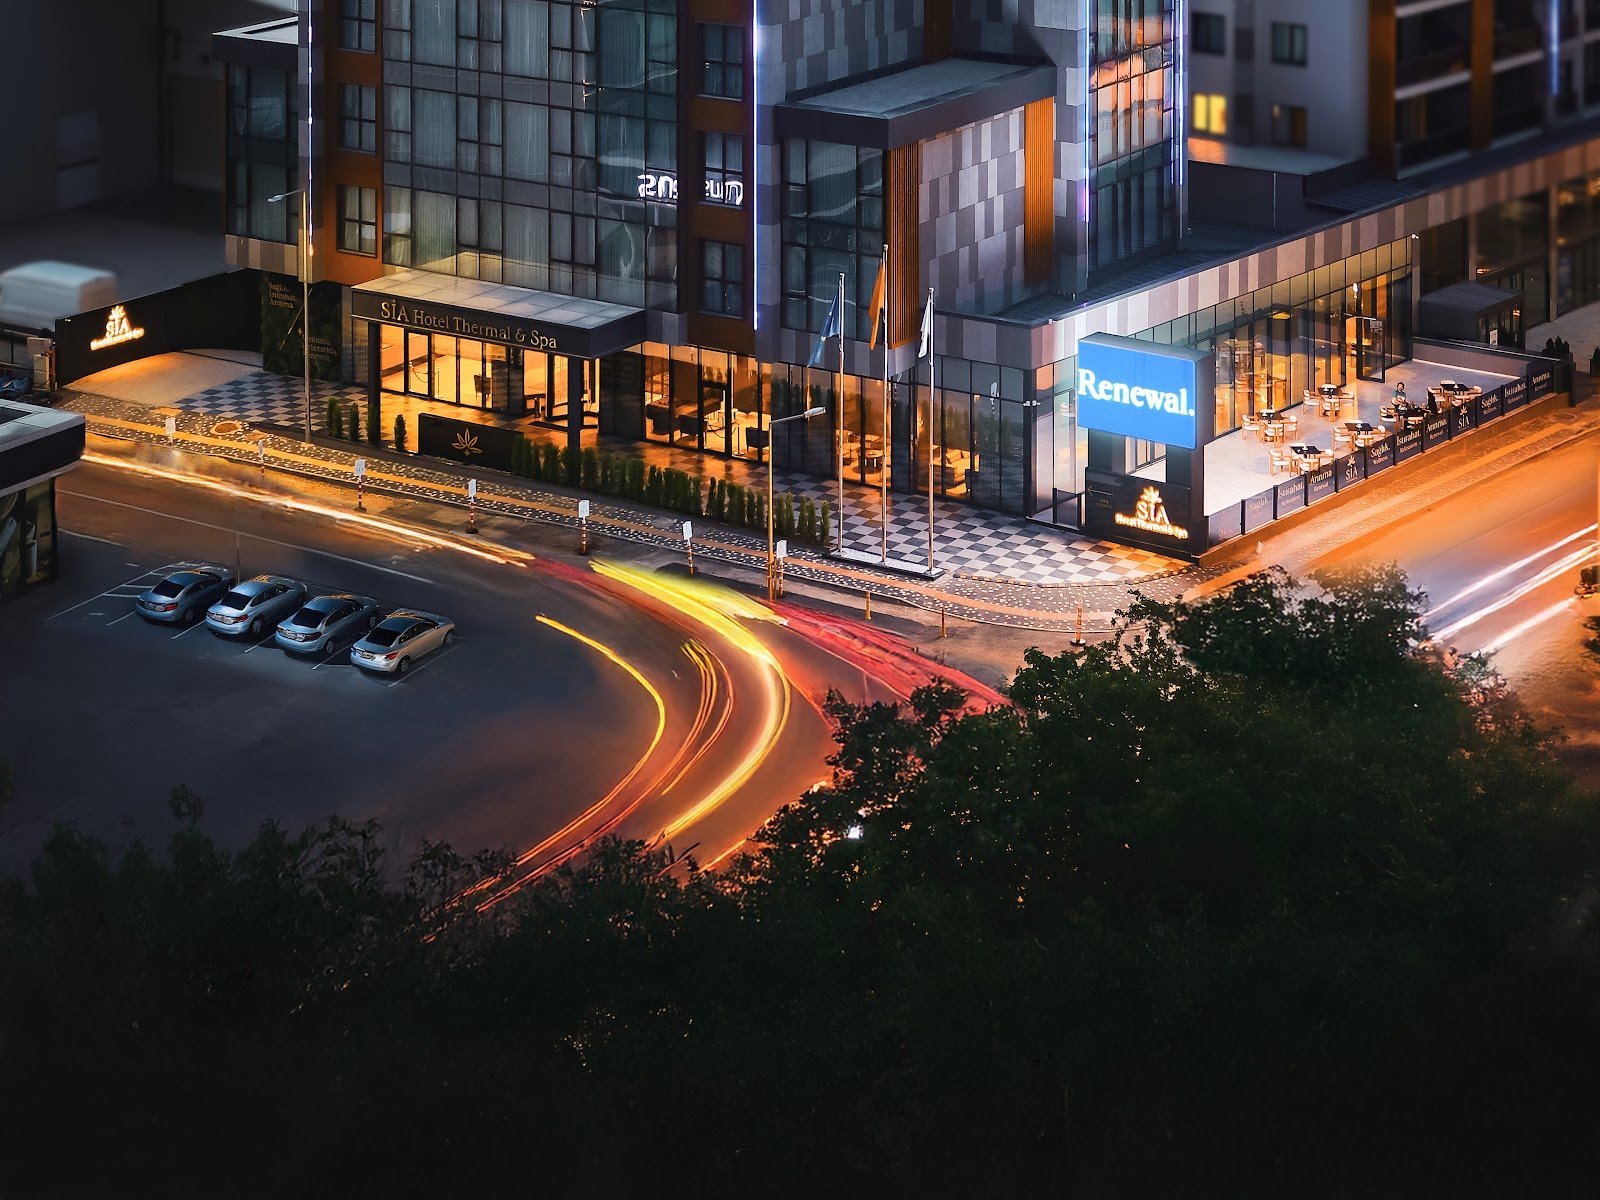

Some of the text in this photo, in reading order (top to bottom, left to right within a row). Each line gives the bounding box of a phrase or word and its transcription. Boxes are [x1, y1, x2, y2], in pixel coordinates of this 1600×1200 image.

[413, 309, 449, 329] Hotel
[453, 316, 510, 341] Thermal
[515, 327, 527, 342] &
[530, 329, 557, 349] Spa
[1078, 368, 1195, 417] Renewal.
